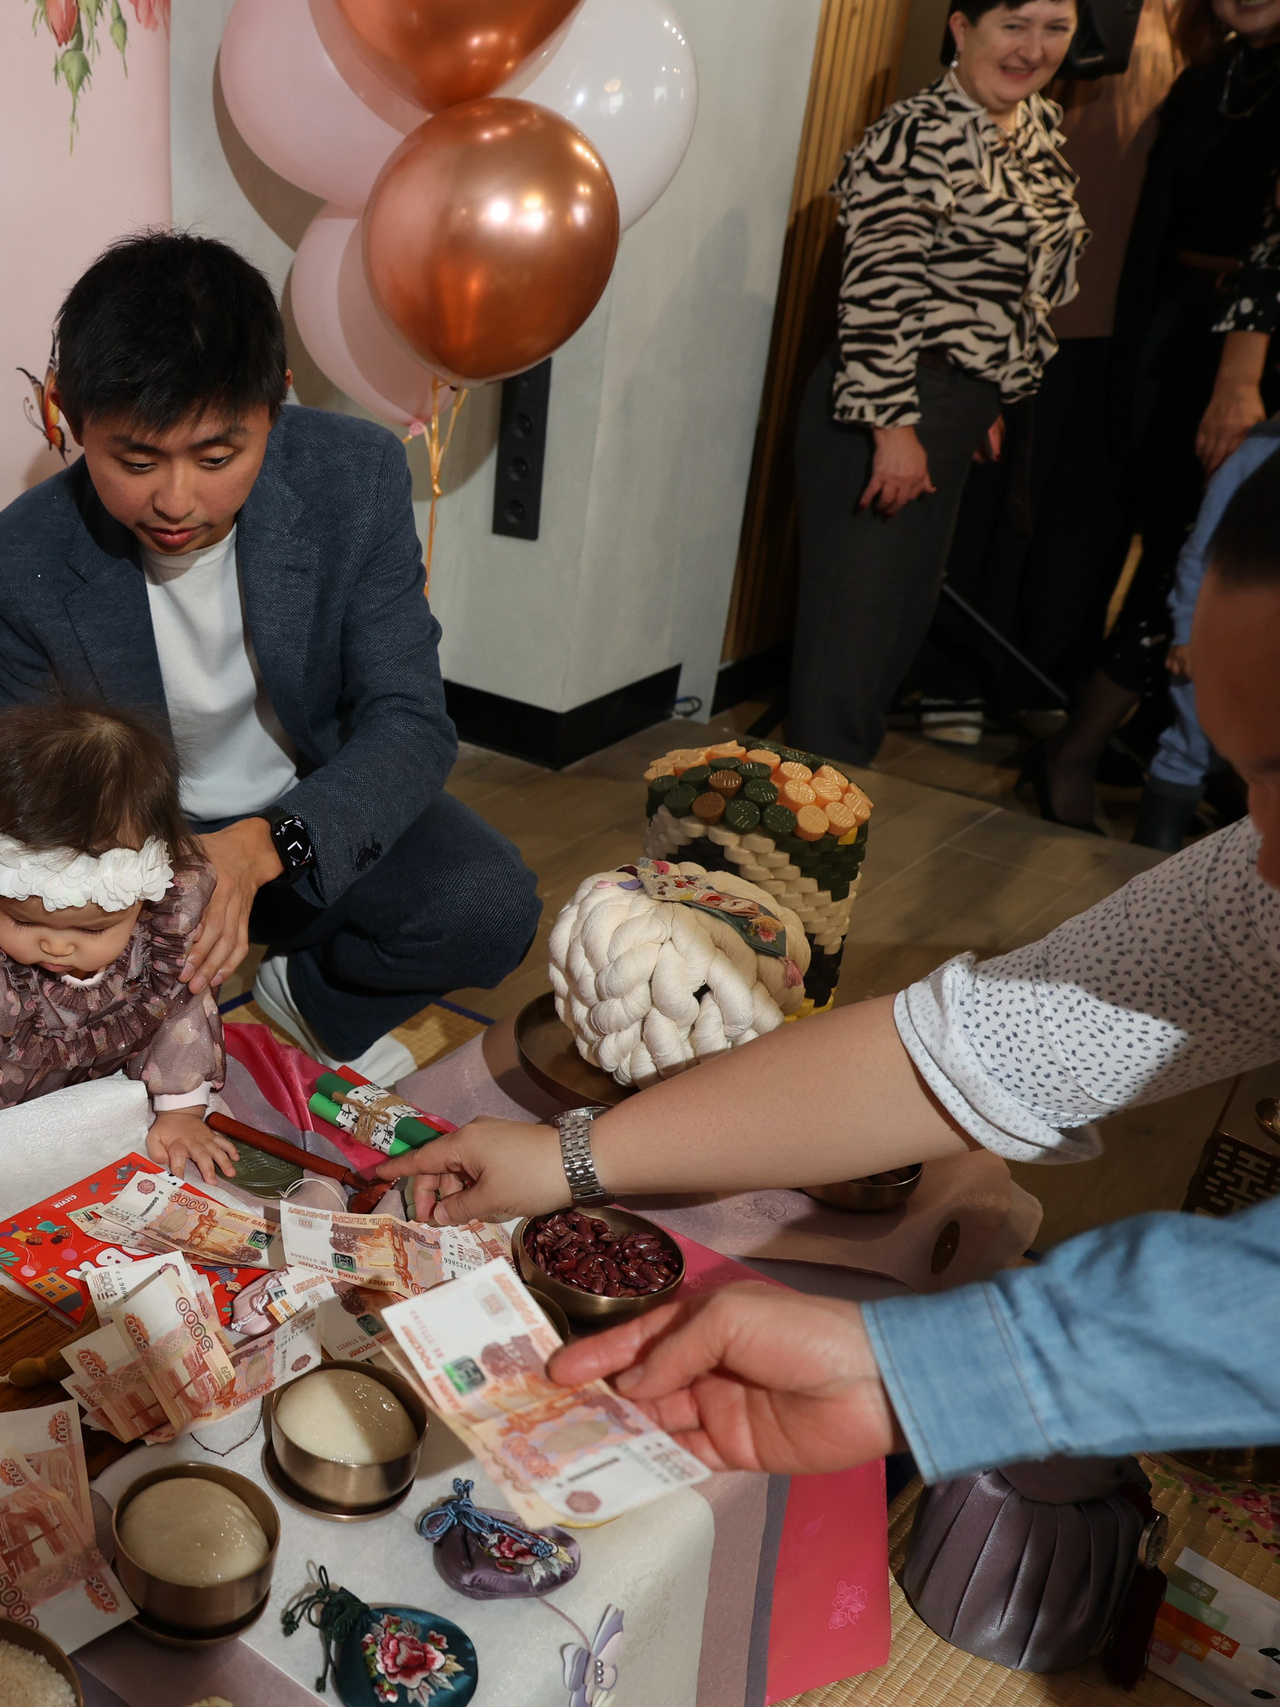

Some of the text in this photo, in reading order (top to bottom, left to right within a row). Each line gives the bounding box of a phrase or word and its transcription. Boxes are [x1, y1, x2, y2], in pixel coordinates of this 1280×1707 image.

[53, 1193, 77, 1209] CLEVER
[168, 1191, 209, 1213] 5000
[226, 1211, 276, 1231] БИЛЕТ БАНКА
[337, 1270, 364, 1281] БАНКА
[367, 1278, 394, 1286] БИЛЕТ
[126, 1317, 149, 1350] 5000
[175, 1297, 213, 1354] 5000
[55, 1413, 68, 1442] 5000
[1, 1458, 25, 1486] 5000
[87, 1575, 118, 1611] 5000
